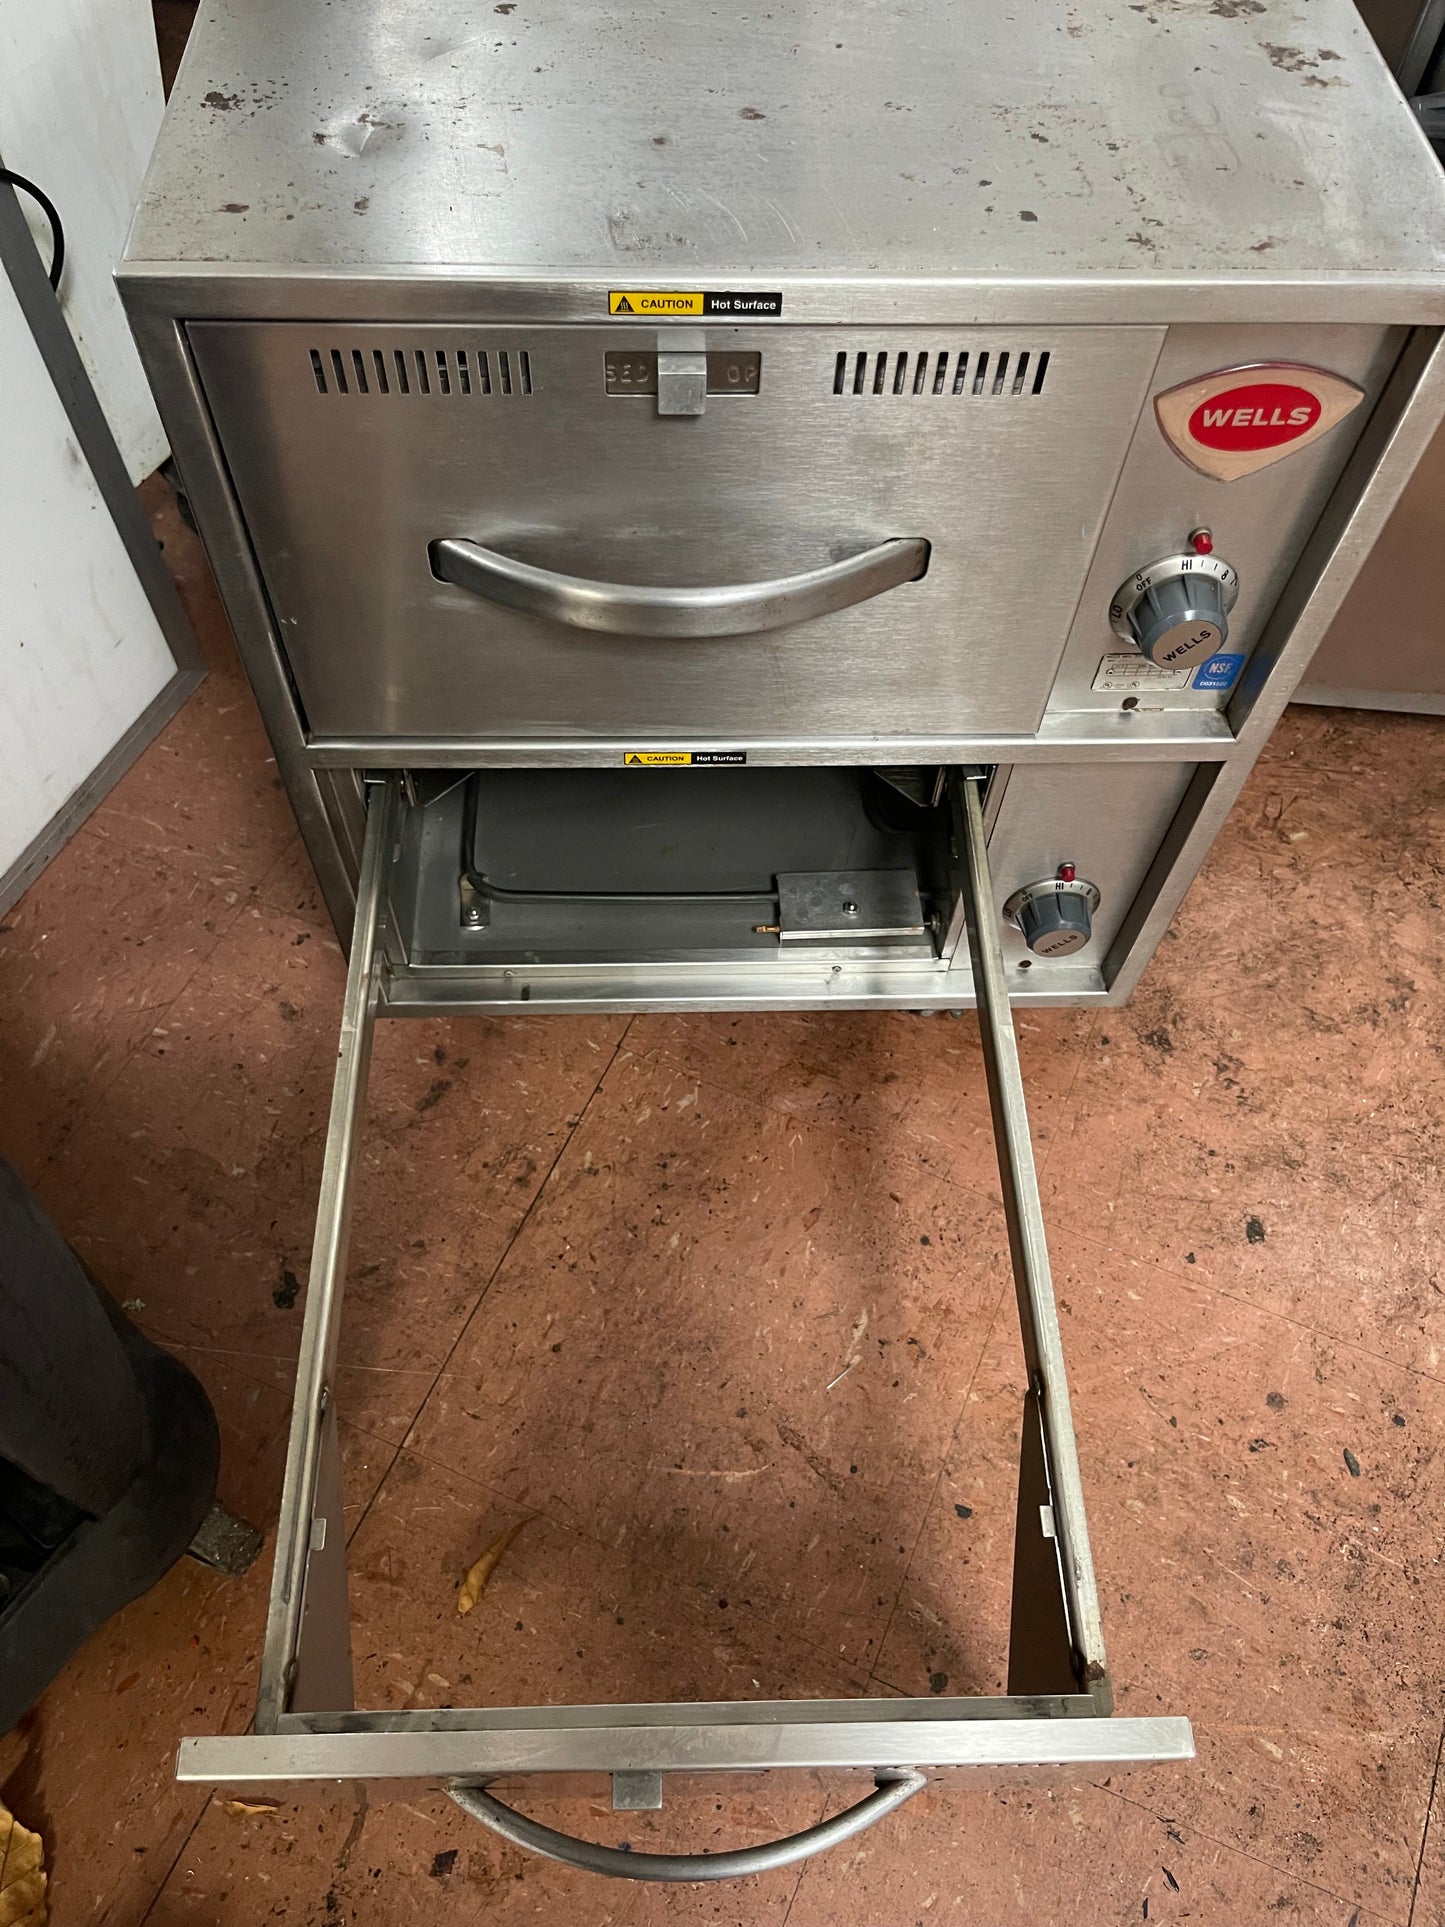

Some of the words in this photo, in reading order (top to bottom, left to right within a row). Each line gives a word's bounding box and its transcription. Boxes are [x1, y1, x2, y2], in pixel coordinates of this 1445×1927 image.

[640, 299, 693, 309] CAUTION
[711, 300, 730, 309] Hot
[734, 300, 776, 310] Surface
[1203, 407, 1312, 427] WELLS
[1181, 560, 1192, 570] HI
[1136, 577, 1152, 591] OFF
[1112, 605, 1123, 618] LO
[1162, 630, 1211, 662] WELLS
[1209, 662, 1233, 673] NSF
[1041, 935, 1078, 954] WELLS
